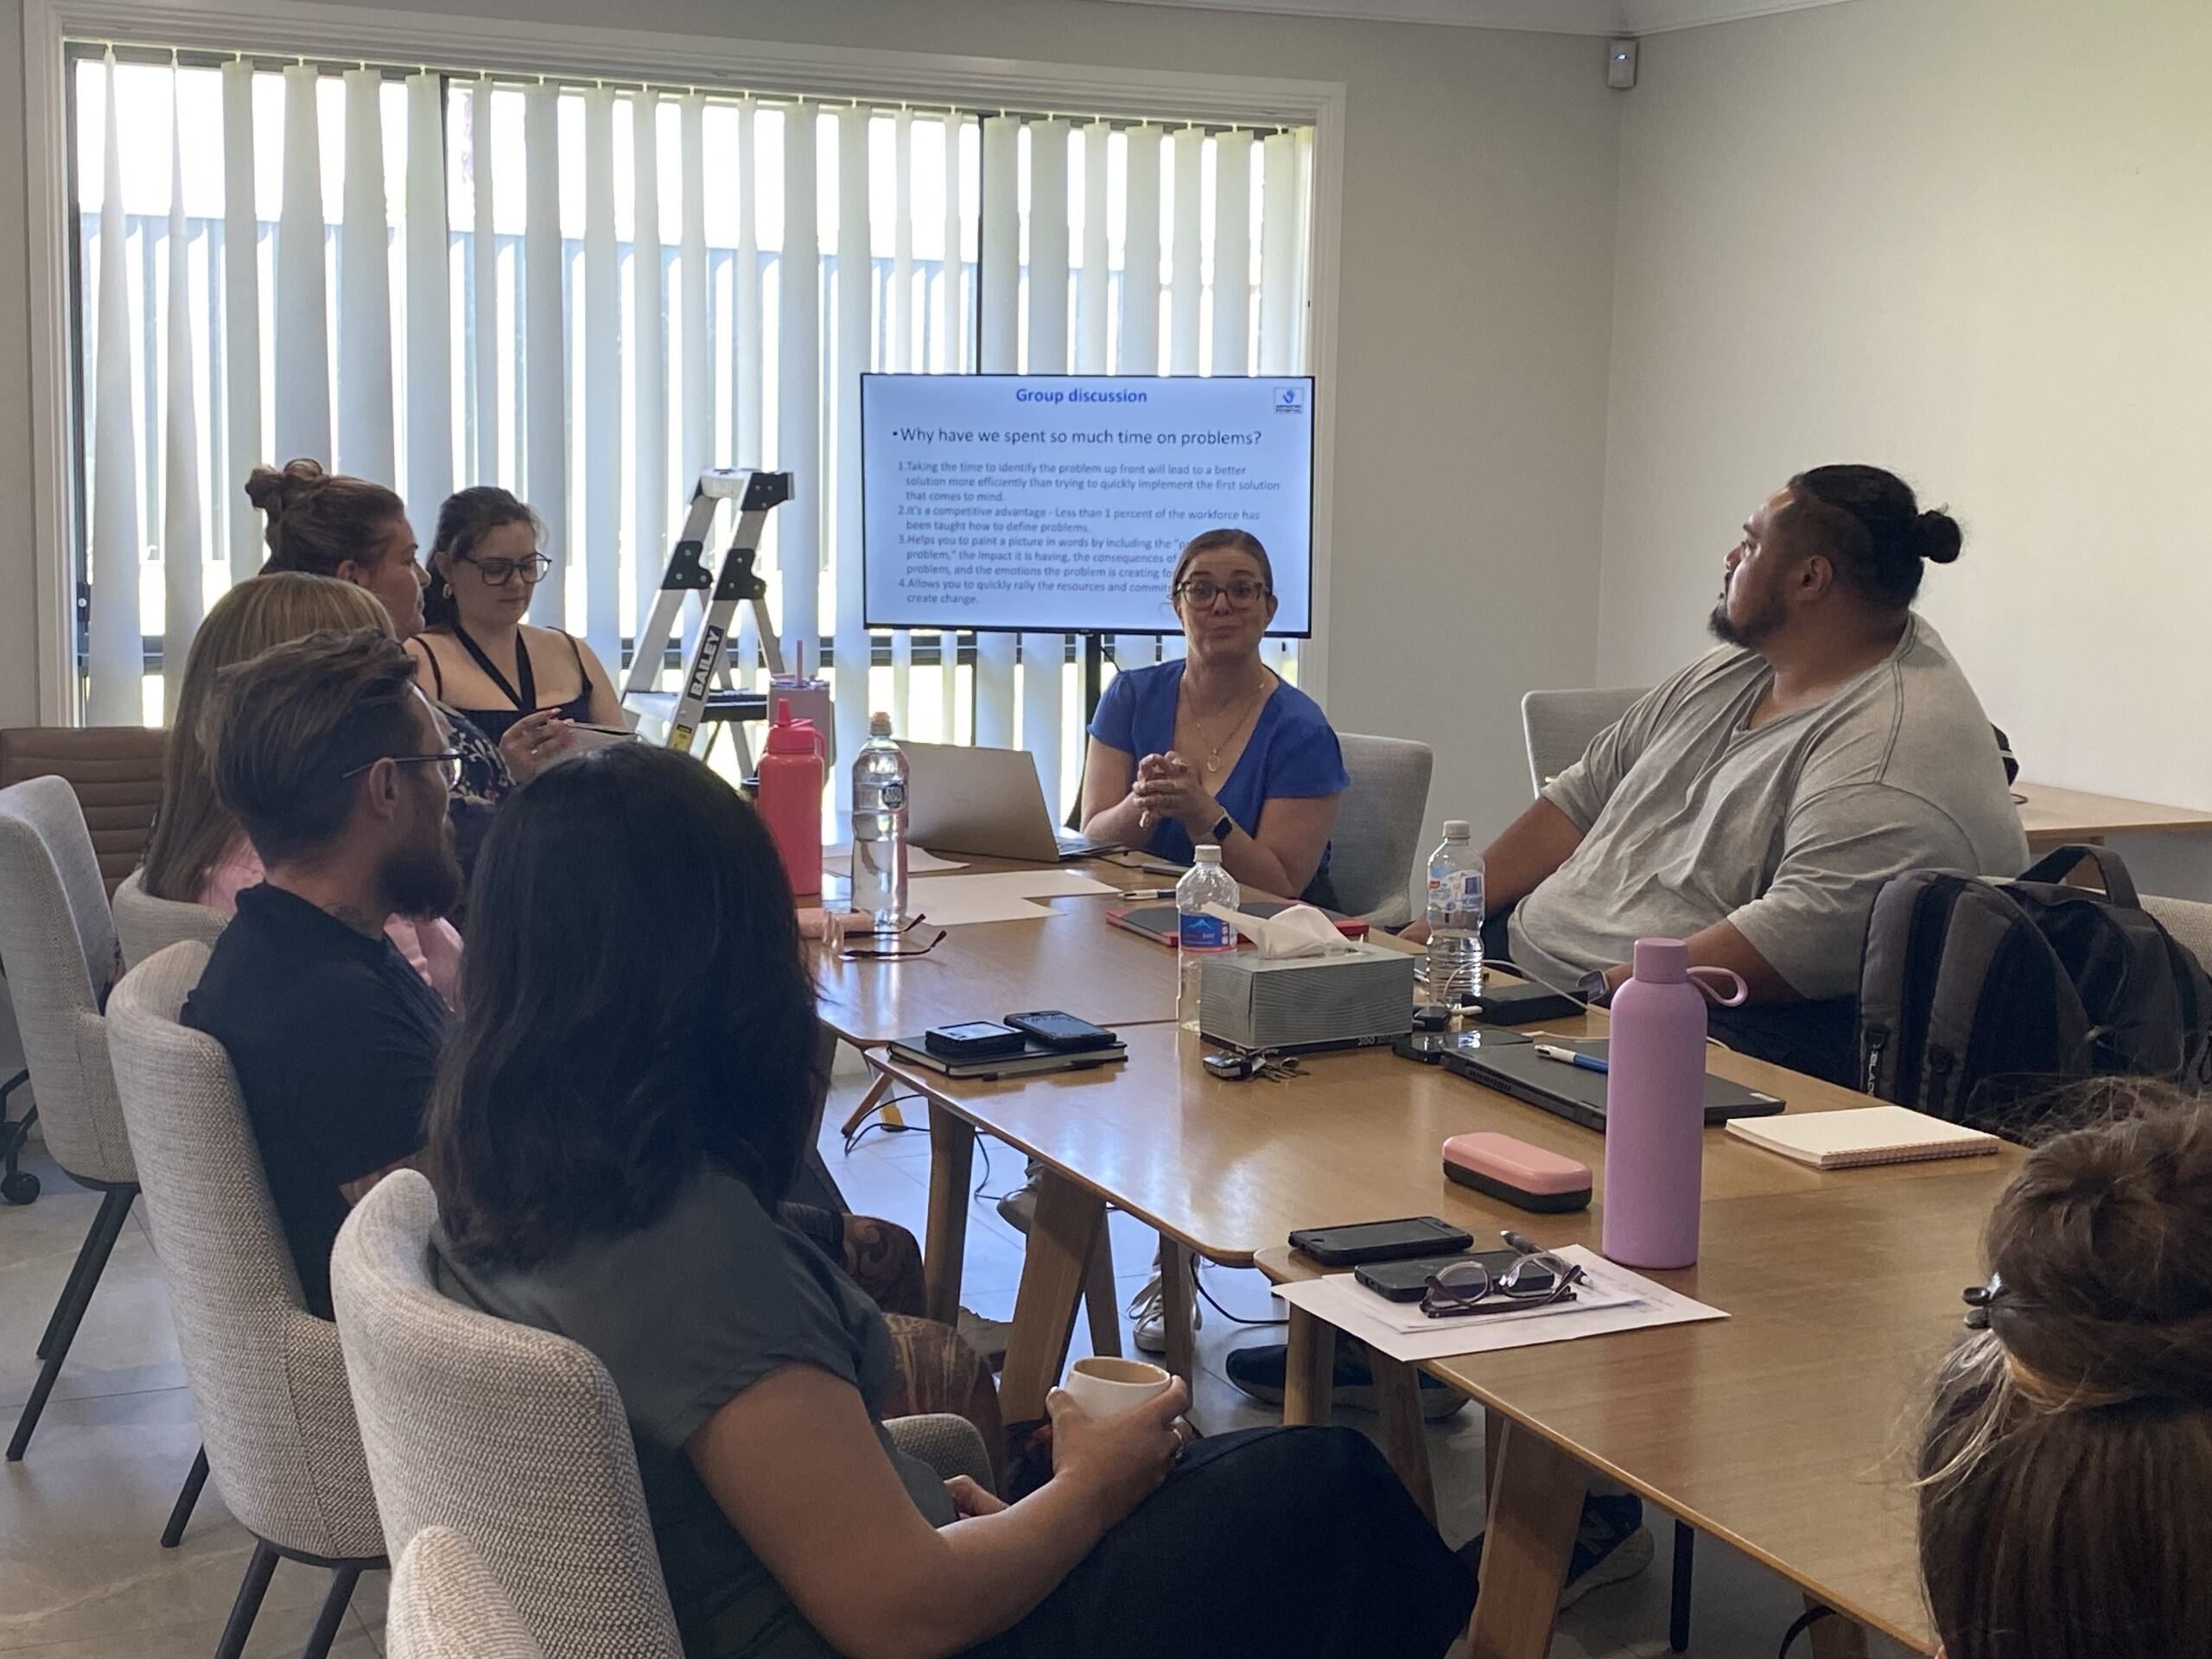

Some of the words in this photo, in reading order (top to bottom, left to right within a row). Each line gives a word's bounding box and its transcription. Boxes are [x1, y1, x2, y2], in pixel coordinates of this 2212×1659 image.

[1016, 388, 1064, 404] Group
[1069, 388, 1147, 403] discussion
[900, 428, 934, 443] Why
[939, 429, 973, 442] have
[978, 432, 1000, 442] we
[1004, 430, 1046, 445] spent
[1051, 433, 1067, 443] so
[1072, 430, 1113, 443] much
[1118, 430, 1152, 444] time
[1157, 434, 1176, 444] on
[1182, 430, 1262, 447] problems?
[941, 461, 957, 472] the
[960, 462, 982, 472] time
[986, 463, 995, 473] to
[999, 462, 1036, 474] identify
[1040, 463, 1055, 473] the
[1059, 463, 1102, 475] problem
[1104, 466, 1116, 475] up
[1121, 464, 1145, 474] front
[1148, 464, 1166, 474] will
[1168, 465, 1189, 474] lead
[1192, 466, 1204, 474] to
[1215, 465, 1246, 475] better
[906, 478, 946, 486] solution
[949, 479, 974, 487] more
[978, 478, 1027, 489] efficiently
[1030, 478, 1052, 487] than
[1055, 479, 1084, 489] trying
[1087, 480, 1097, 488] to
[1101, 480, 1135, 490] quickly
[1138, 480, 1192, 491] implement
[1197, 480, 1212, 490] the
[1216, 480, 1235, 490] first
[1239, 480, 1280, 490] solution
[906, 492, 925, 500] that
[964, 493, 974, 501] to
[976, 493, 1004, 501] mind.
[933, 506, 992, 518] competitive
[995, 506, 1046, 518] advantage
[1055, 507, 1076, 518] Less
[1080, 508, 1102, 518] than
[1106, 509, 1110, 518] 1
[1114, 510, 1151, 519] percent
[1155, 509, 1166, 518] of
[1168, 510, 1185, 518] the
[1189, 510, 1239, 519] workforce
[1242, 510, 1260, 519] has
[906, 520, 931, 530] been
[934, 521, 965, 532] taught
[969, 521, 989, 531] how
[994, 522, 1003, 531] to
[1007, 521, 1038, 531] define
[1041, 522, 1088, 533] problems.
[938, 537, 956, 547] you
[959, 537, 969, 545] to
[971, 537, 997, 547] paint
[1008, 537, 1043, 548] picture
[1046, 537, 1055, 546] in
[1058, 537, 1089, 547] words
[1092, 537, 1103, 548] by
[1107, 538, 1152, 550] including
[1155, 538, 1171, 548] the
[959, 550, 976, 560] the
[978, 551, 1012, 562] impact
[1015, 551, 1021, 561] it
[1025, 551, 1033, 561] is
[1074, 552, 1090, 562] the
[1093, 554, 1165, 563] consequences
[907, 565, 950, 575] problem,
[954, 565, 973, 575] and
[976, 566, 992, 575] the
[995, 566, 1041, 575] emotions
[1045, 566, 1060, 575] the
[1064, 567, 1106, 577] problem
[1109, 568, 1116, 576] is
[1119, 568, 1160, 579] creating
[1163, 568, 1172, 577] fo
[943, 581, 961, 590] you
[964, 580, 974, 589] to
[976, 581, 1011, 591] quickly
[1014, 581, 1035, 591] rally
[1038, 581, 1054, 590] the
[1057, 582, 1105, 592] resources
[1108, 582, 1127, 591] and
[1129, 582, 1171, 592] commit
[907, 594, 938, 603] create
[940, 594, 979, 605] change.
[690, 630, 721, 696] BAILEY
[1357, 1035, 1376, 1046] 200
